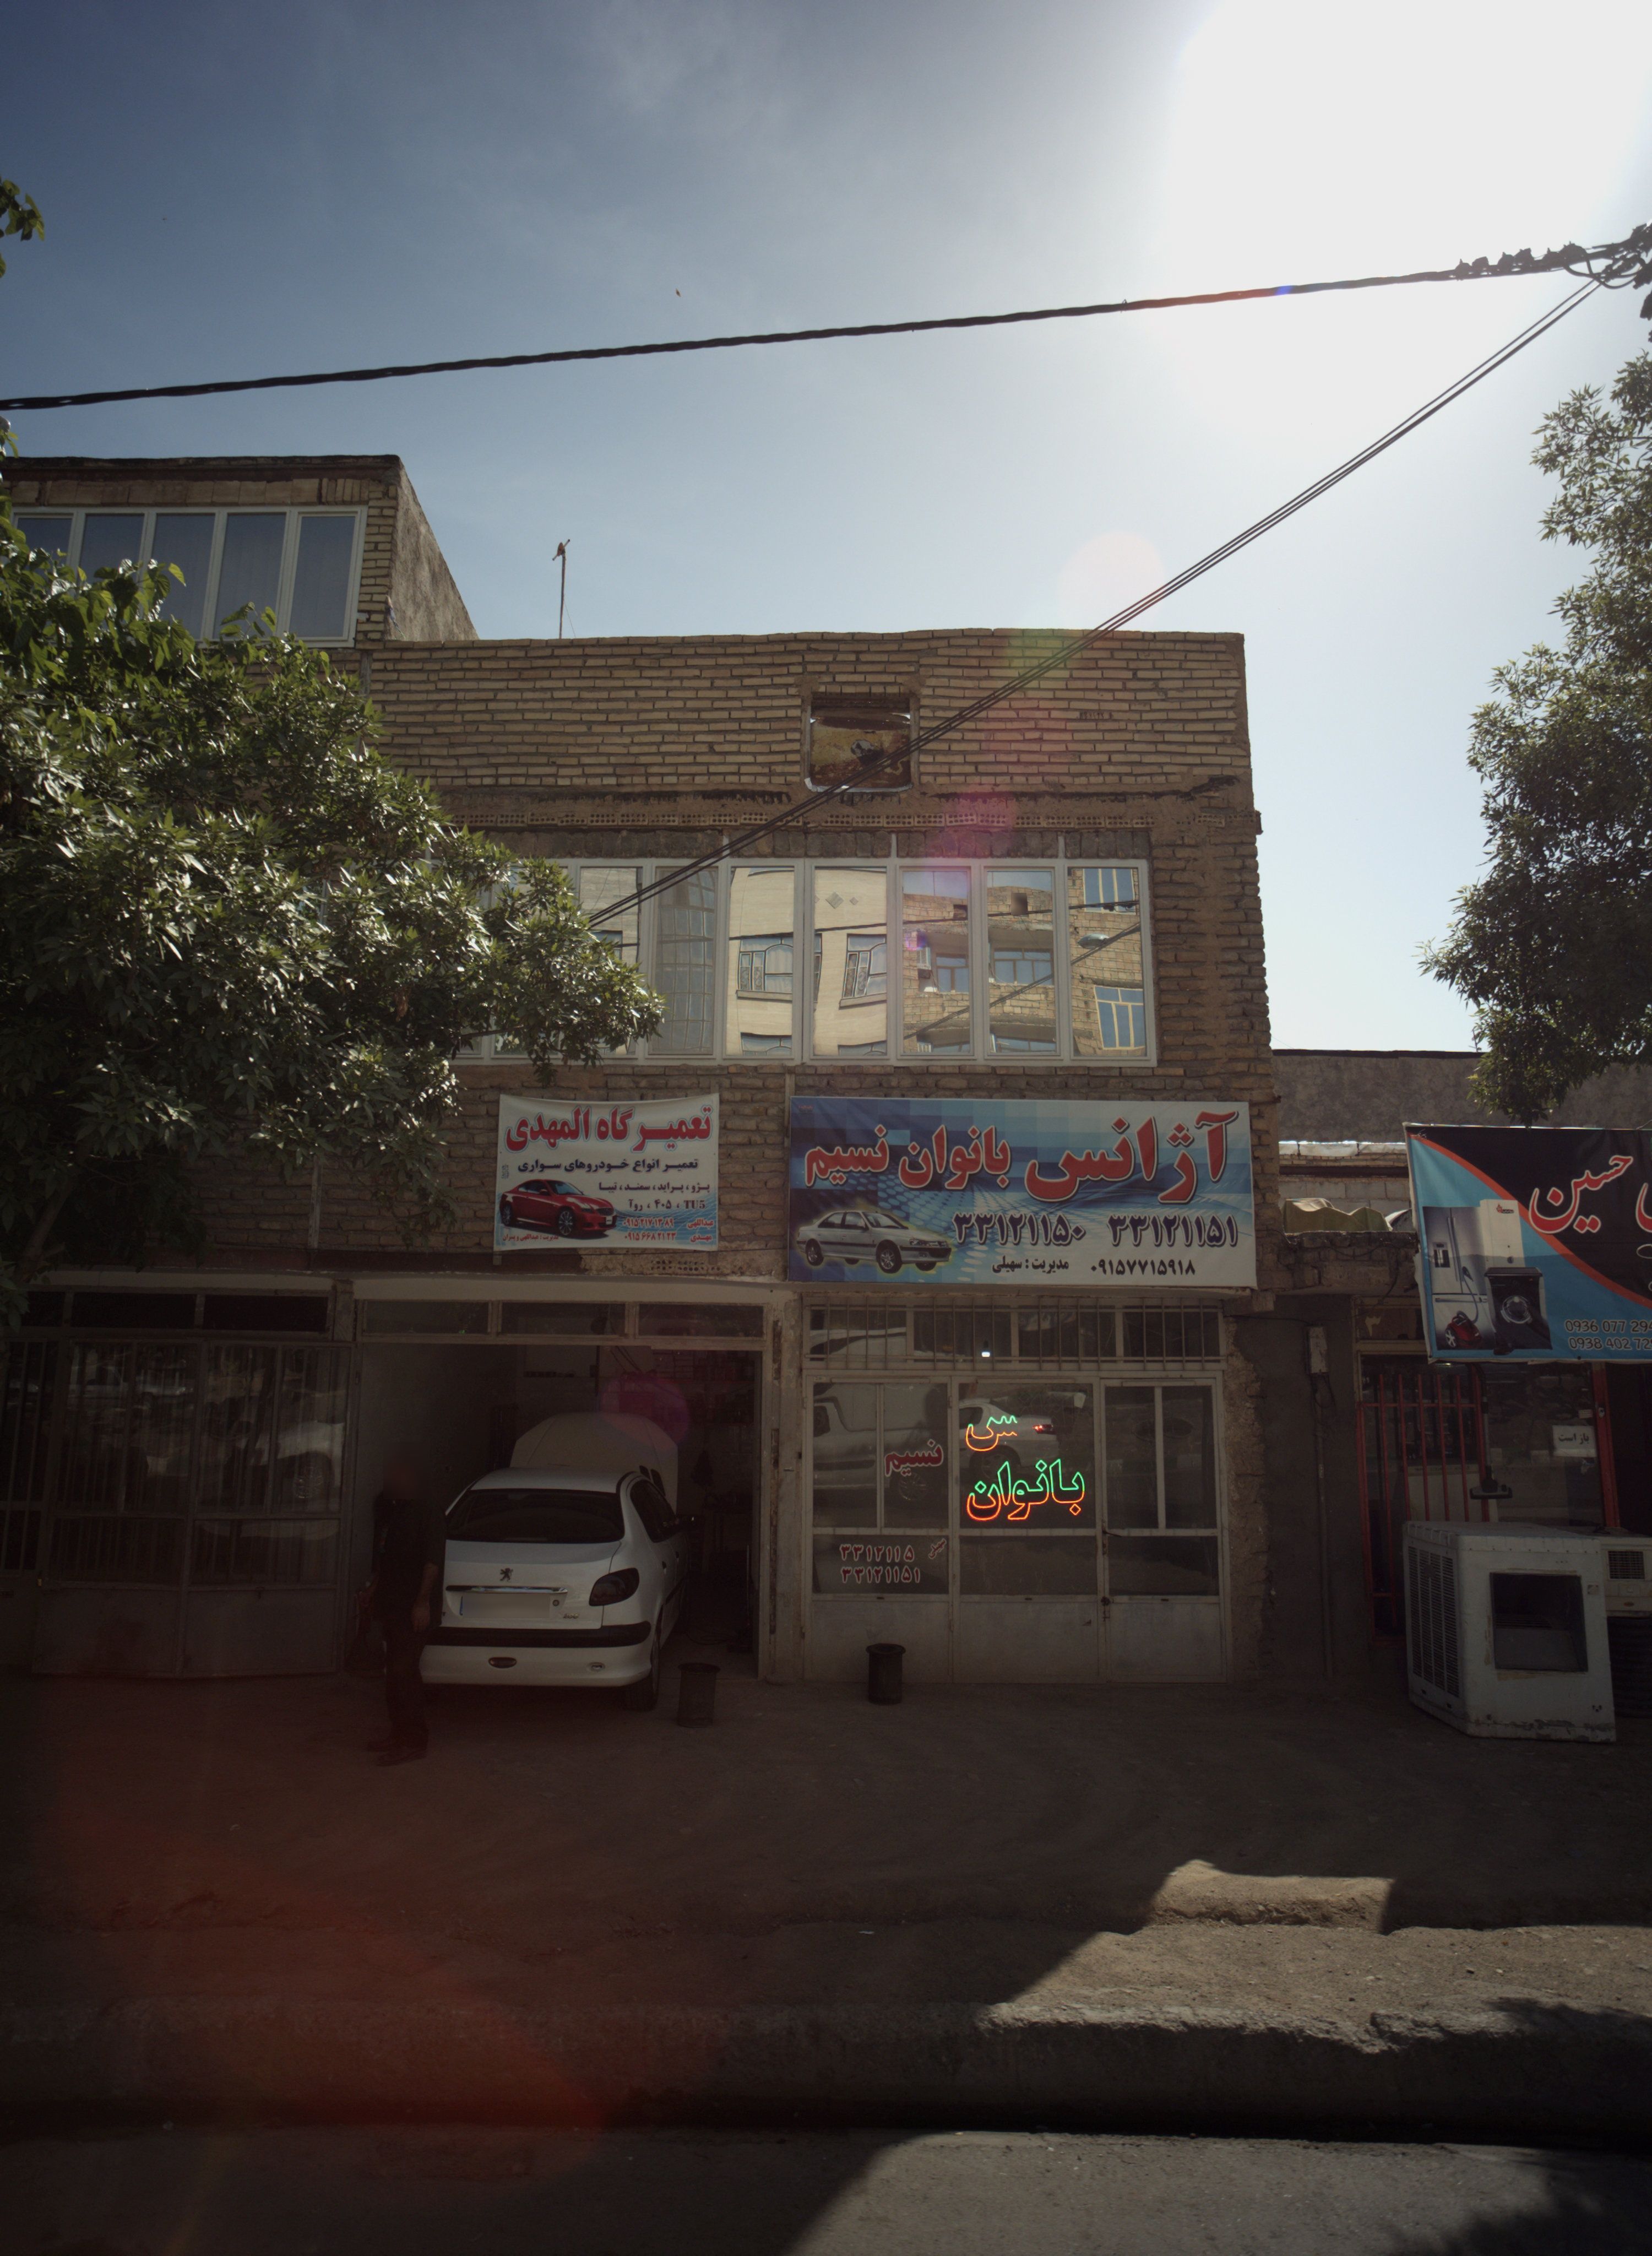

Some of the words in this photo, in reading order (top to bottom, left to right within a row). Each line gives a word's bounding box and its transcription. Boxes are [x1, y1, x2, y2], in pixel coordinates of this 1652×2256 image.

[505, 1105, 591, 1152] المهدی
[518, 1159, 561, 1173] سواری
[564, 1158, 629, 1173] خودروهای
[632, 1158, 660, 1172] انواع
[662, 1158, 698, 1173] تعمیر
[805, 1124, 889, 1189] نسیم
[898, 1124, 1011, 1190] بانوان
[1024, 1111, 1240, 1203] آژانس
[599, 1182, 617, 1193] تیبا
[1529, 1155, 1633, 1234] حسین
[952, 1212, 1086, 1245] ۳۳۱۲۱۱۵۰
[1107, 1214, 1238, 1247] ۳۳۱۲۱۱۵۱
[992, 1255, 1023, 1274] سهیلی
[1090, 1258, 1196, 1276] ۰۹۱۵۷۷۱۵۹۱۸
[1565, 1320, 1599, 1333] 0936
[1602, 1320, 1626, 1333] 077
[1568, 1337, 1603, 1350] 0938
[1606, 1337, 1631, 1350] 402
[1558, 1432, 1577, 1442] است
[884, 1439, 944, 1477] نسیم
[966, 1457, 1086, 1521] بانوان
[840, 1565, 921, 1585] ۳۳۱۲۱۱۵۱
